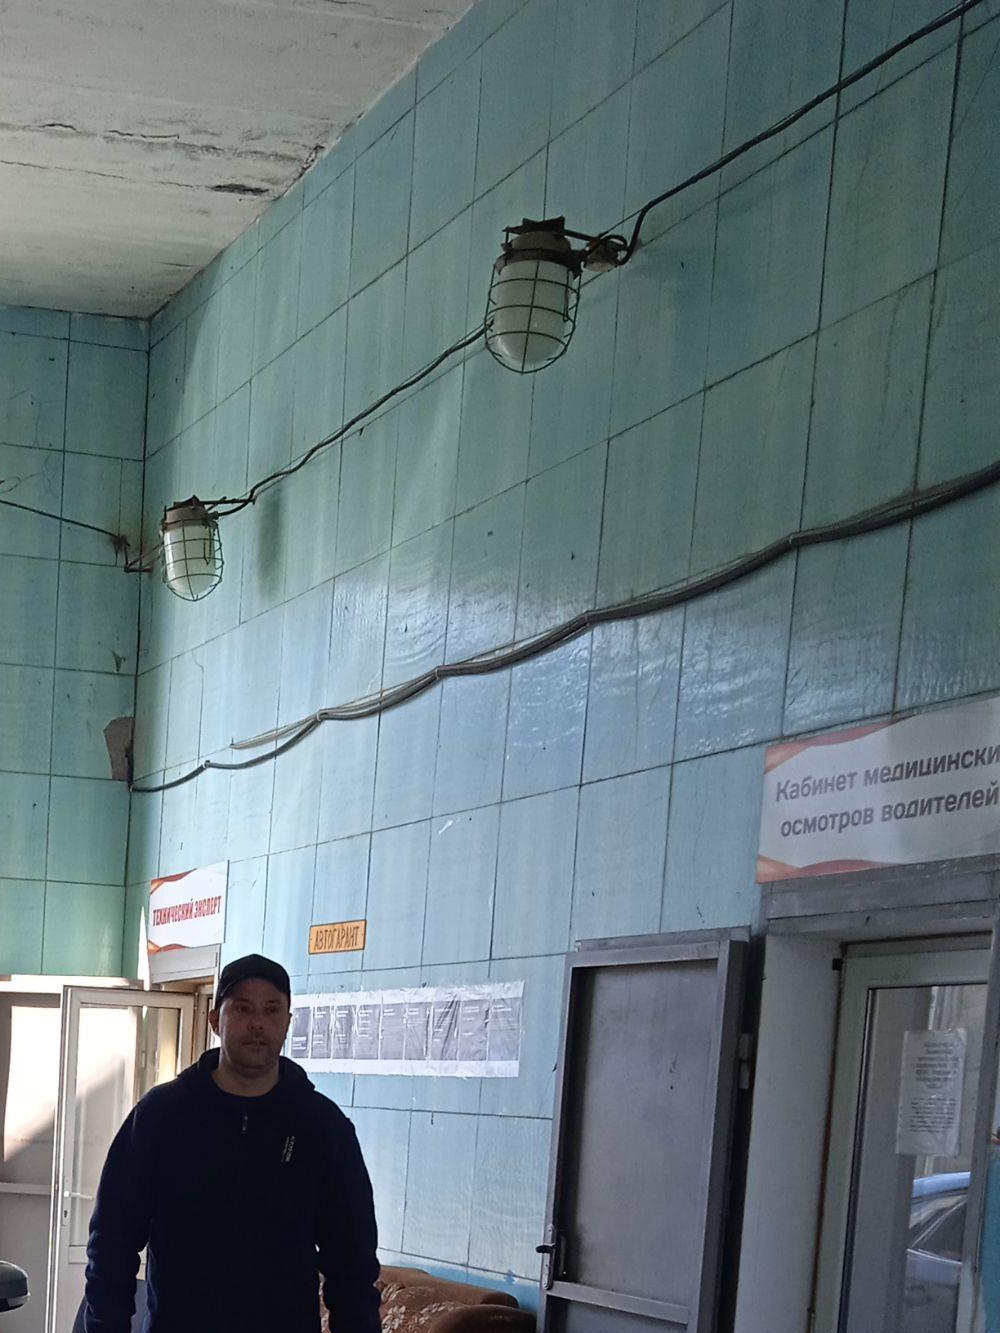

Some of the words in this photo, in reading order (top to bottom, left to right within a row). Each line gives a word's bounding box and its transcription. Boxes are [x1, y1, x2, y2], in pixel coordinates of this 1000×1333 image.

[776, 772, 857, 802] Кабинет
[780, 807, 874, 838] осмотров
[880, 780, 999, 822] водителей
[153, 898, 194, 926] ТЕХНИЧЕСКИЙ
[313, 924, 360, 951] АВТОГАРАНТ
